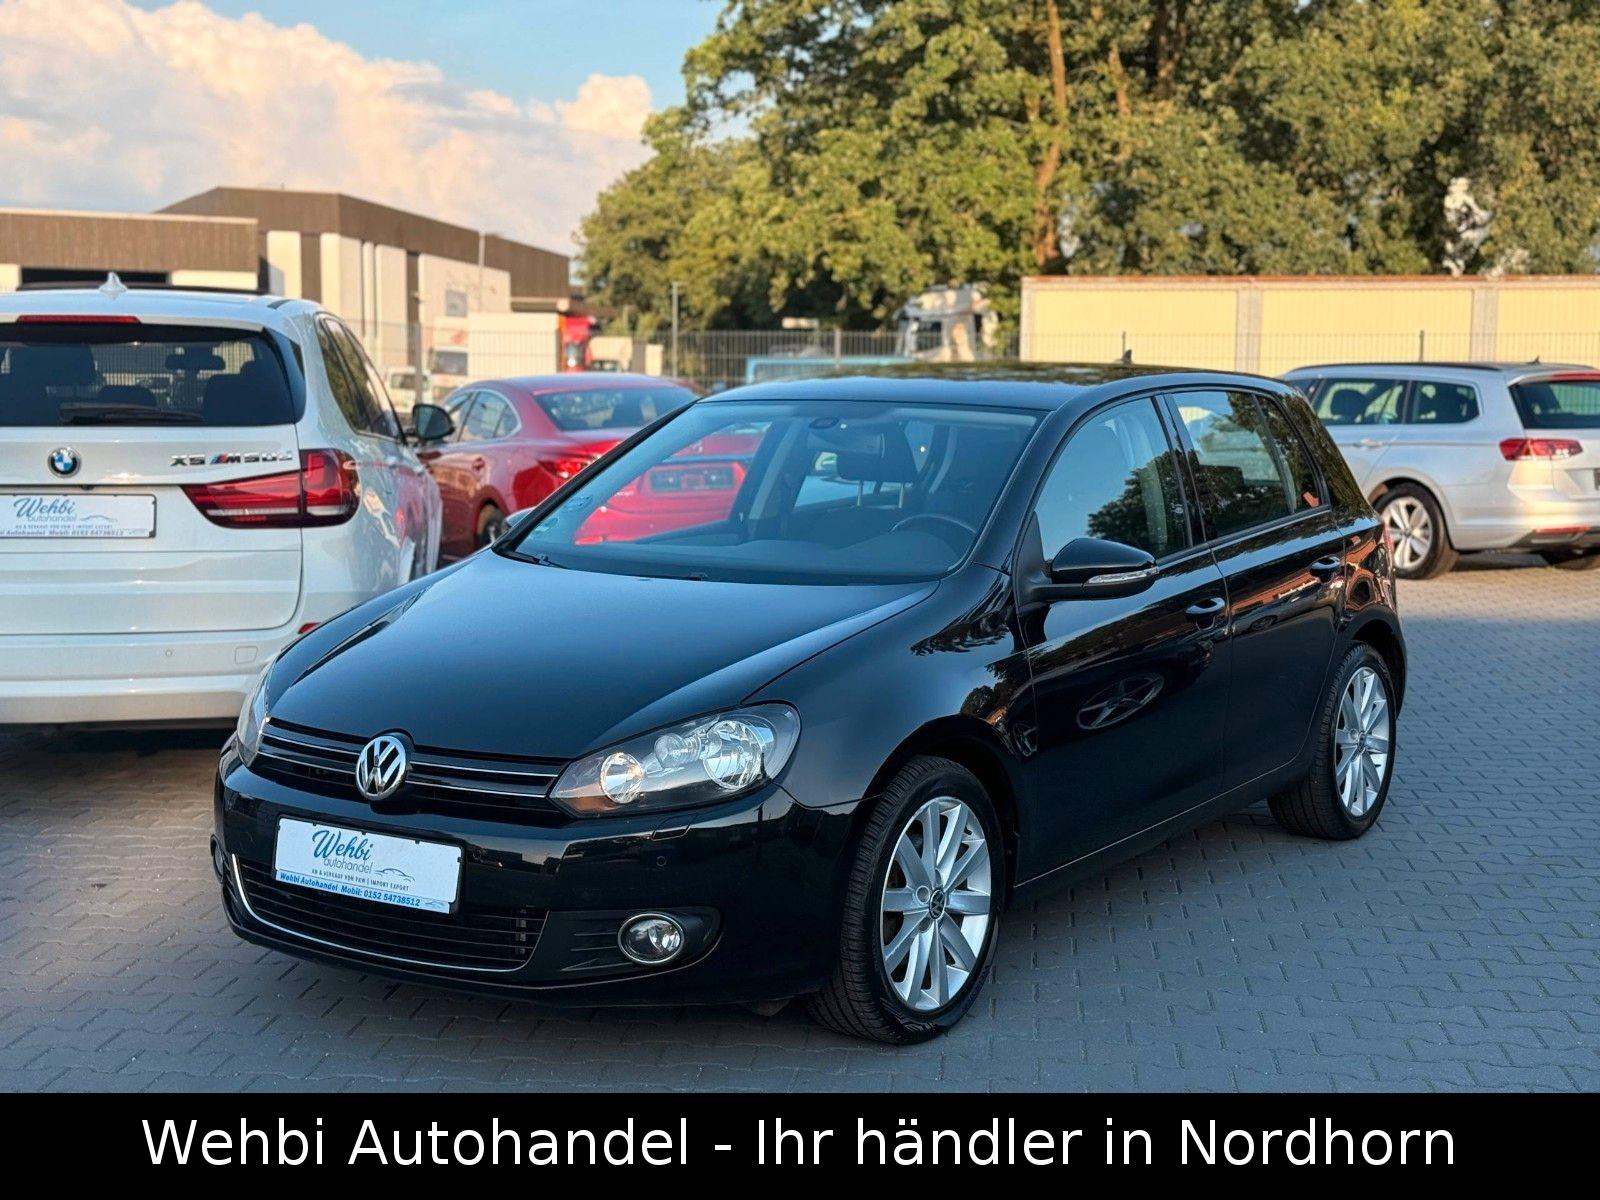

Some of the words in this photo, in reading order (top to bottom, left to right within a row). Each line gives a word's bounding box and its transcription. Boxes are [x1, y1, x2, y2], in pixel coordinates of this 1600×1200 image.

[170, 454, 206, 467] X5
[14, 497, 76, 518] Wehbi
[312, 829, 374, 861] Wehbi
[323, 857, 374, 875] autohandel
[280, 872, 300, 882] Wehbi
[300, 876, 339, 892] Autohandel
[340, 885, 363, 896] Mobil:
[363, 889, 382, 899] 0152
[383, 892, 421, 907] 54738512
[370, 879, 389, 887] IMPORT
[390, 883, 410, 891] EXPORT
